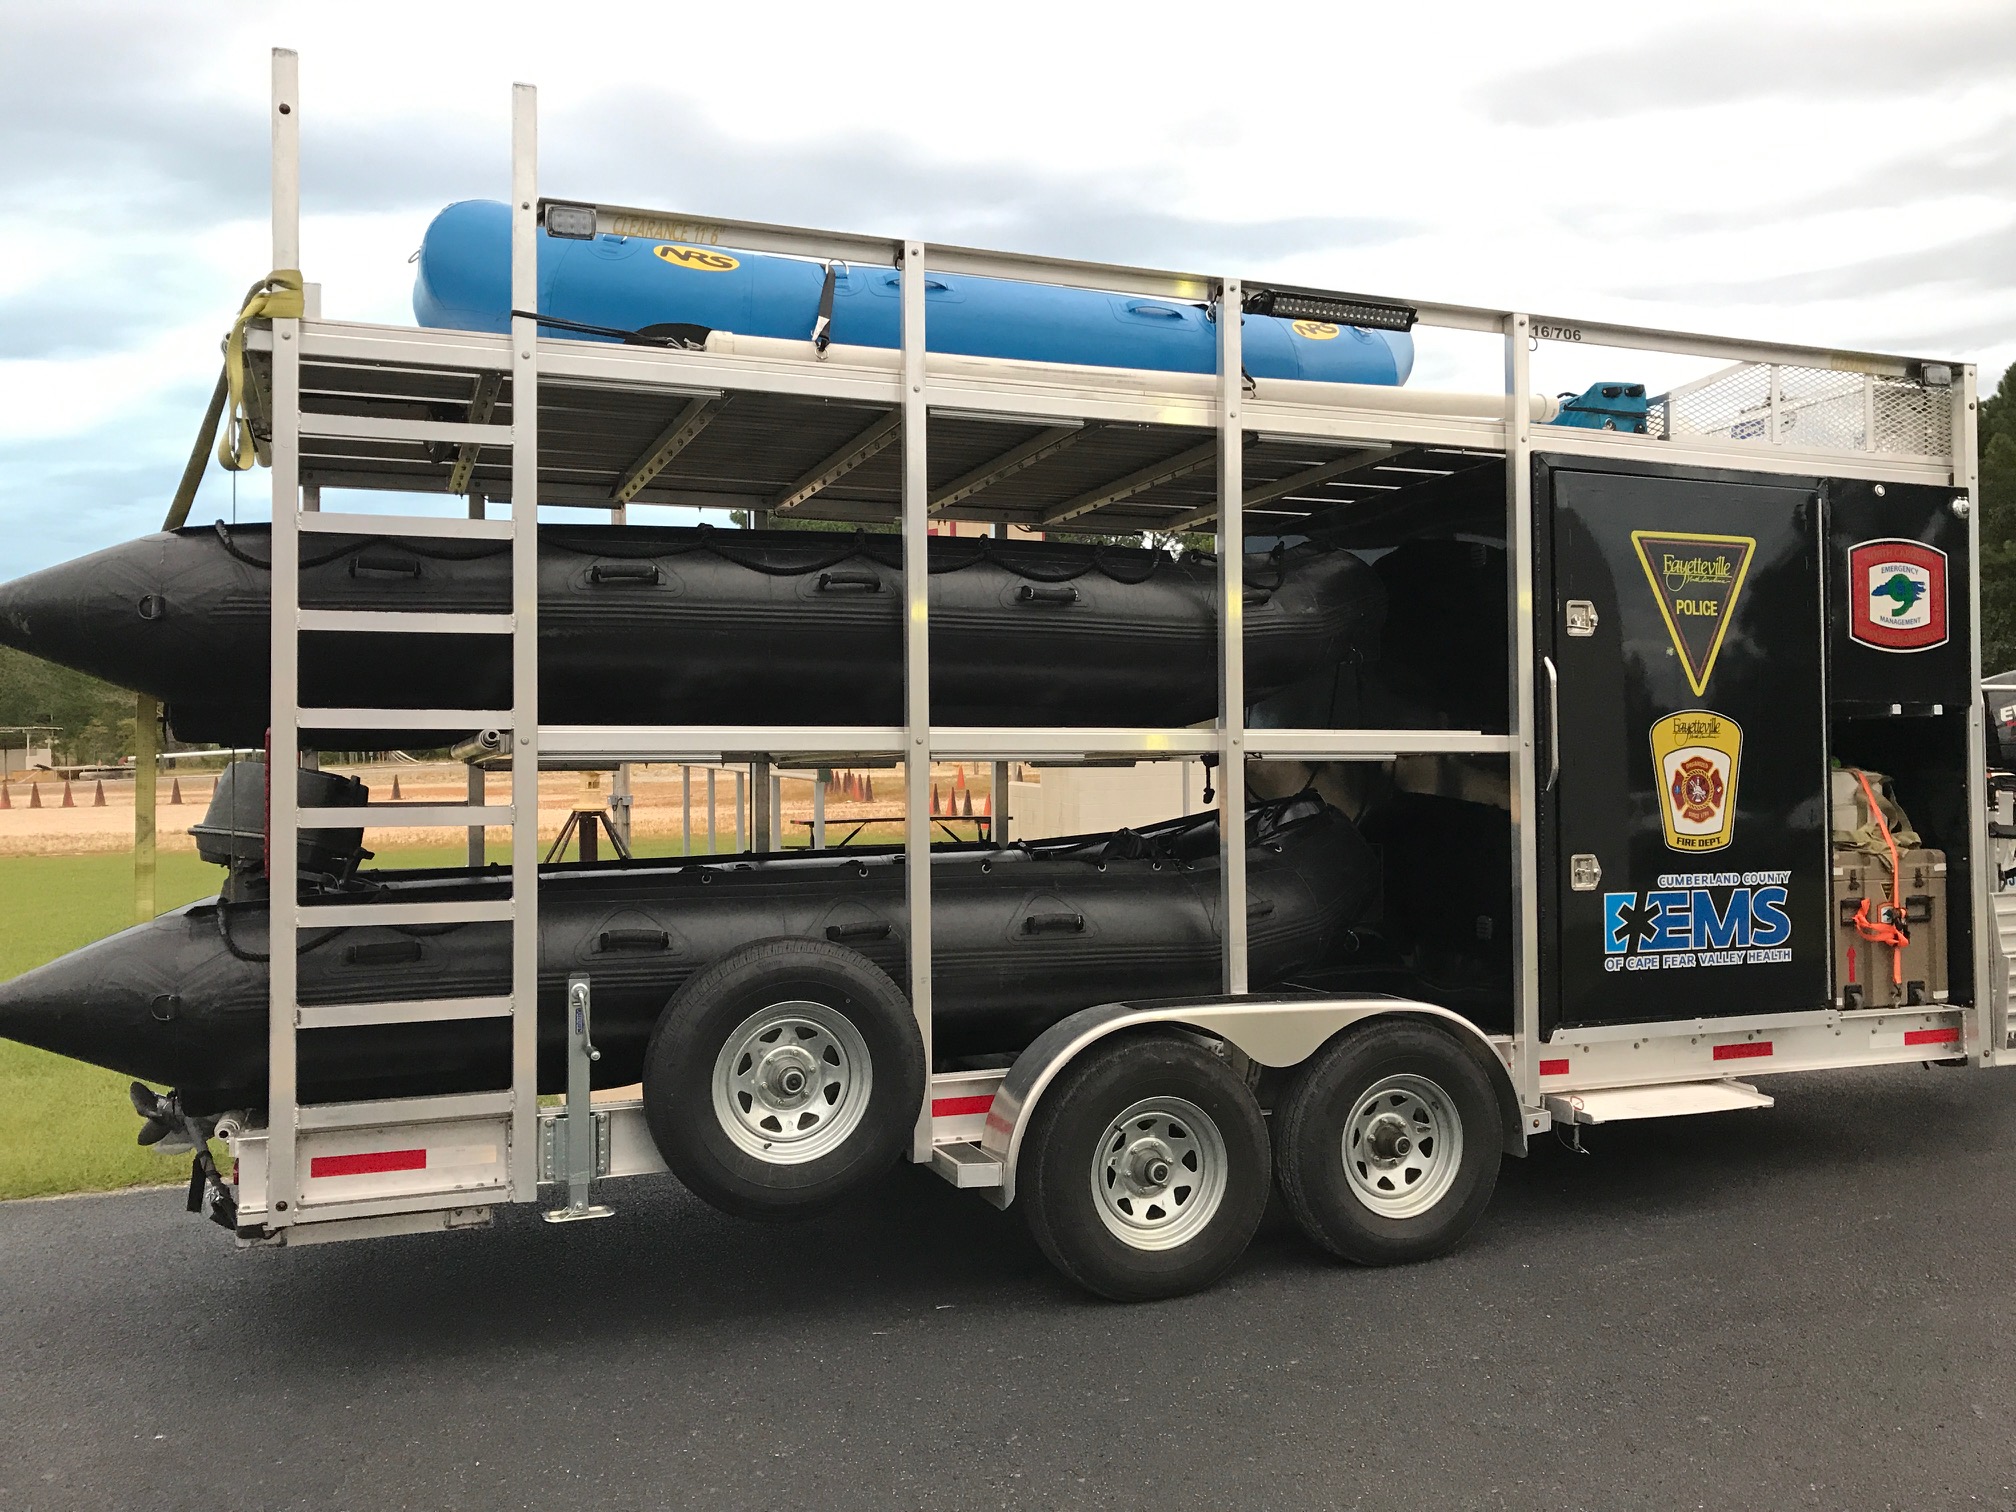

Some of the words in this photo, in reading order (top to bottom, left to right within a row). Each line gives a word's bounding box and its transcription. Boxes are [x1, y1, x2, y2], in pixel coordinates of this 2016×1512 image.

[613, 217, 687, 242] CLEARANCE
[660, 246, 733, 268] NRS
[1532, 325, 1581, 341] 16/706
[1663, 554, 1731, 591] Fayetteville
[1881, 565, 1919, 575] EMERGENCY
[1676, 600, 1718, 616] POLICE
[1880, 615, 1921, 626] MANAGEMENT
[1673, 718, 1720, 745] Fayetteville
[1676, 837, 1696, 847] FIRE
[1698, 837, 1722, 847] DEPT.
[1658, 873, 1739, 888] CUMBERLAND
[1742, 871, 1792, 885] COUNTY
[1637, 886, 1792, 953] EMS
[1605, 957, 1623, 972] OF
[1625, 955, 1660, 970] CAPE
[1663, 953, 1695, 968] FEAR
[1699, 951, 1746, 967] VALLEY
[1747, 948, 1792, 964] HEALTH
